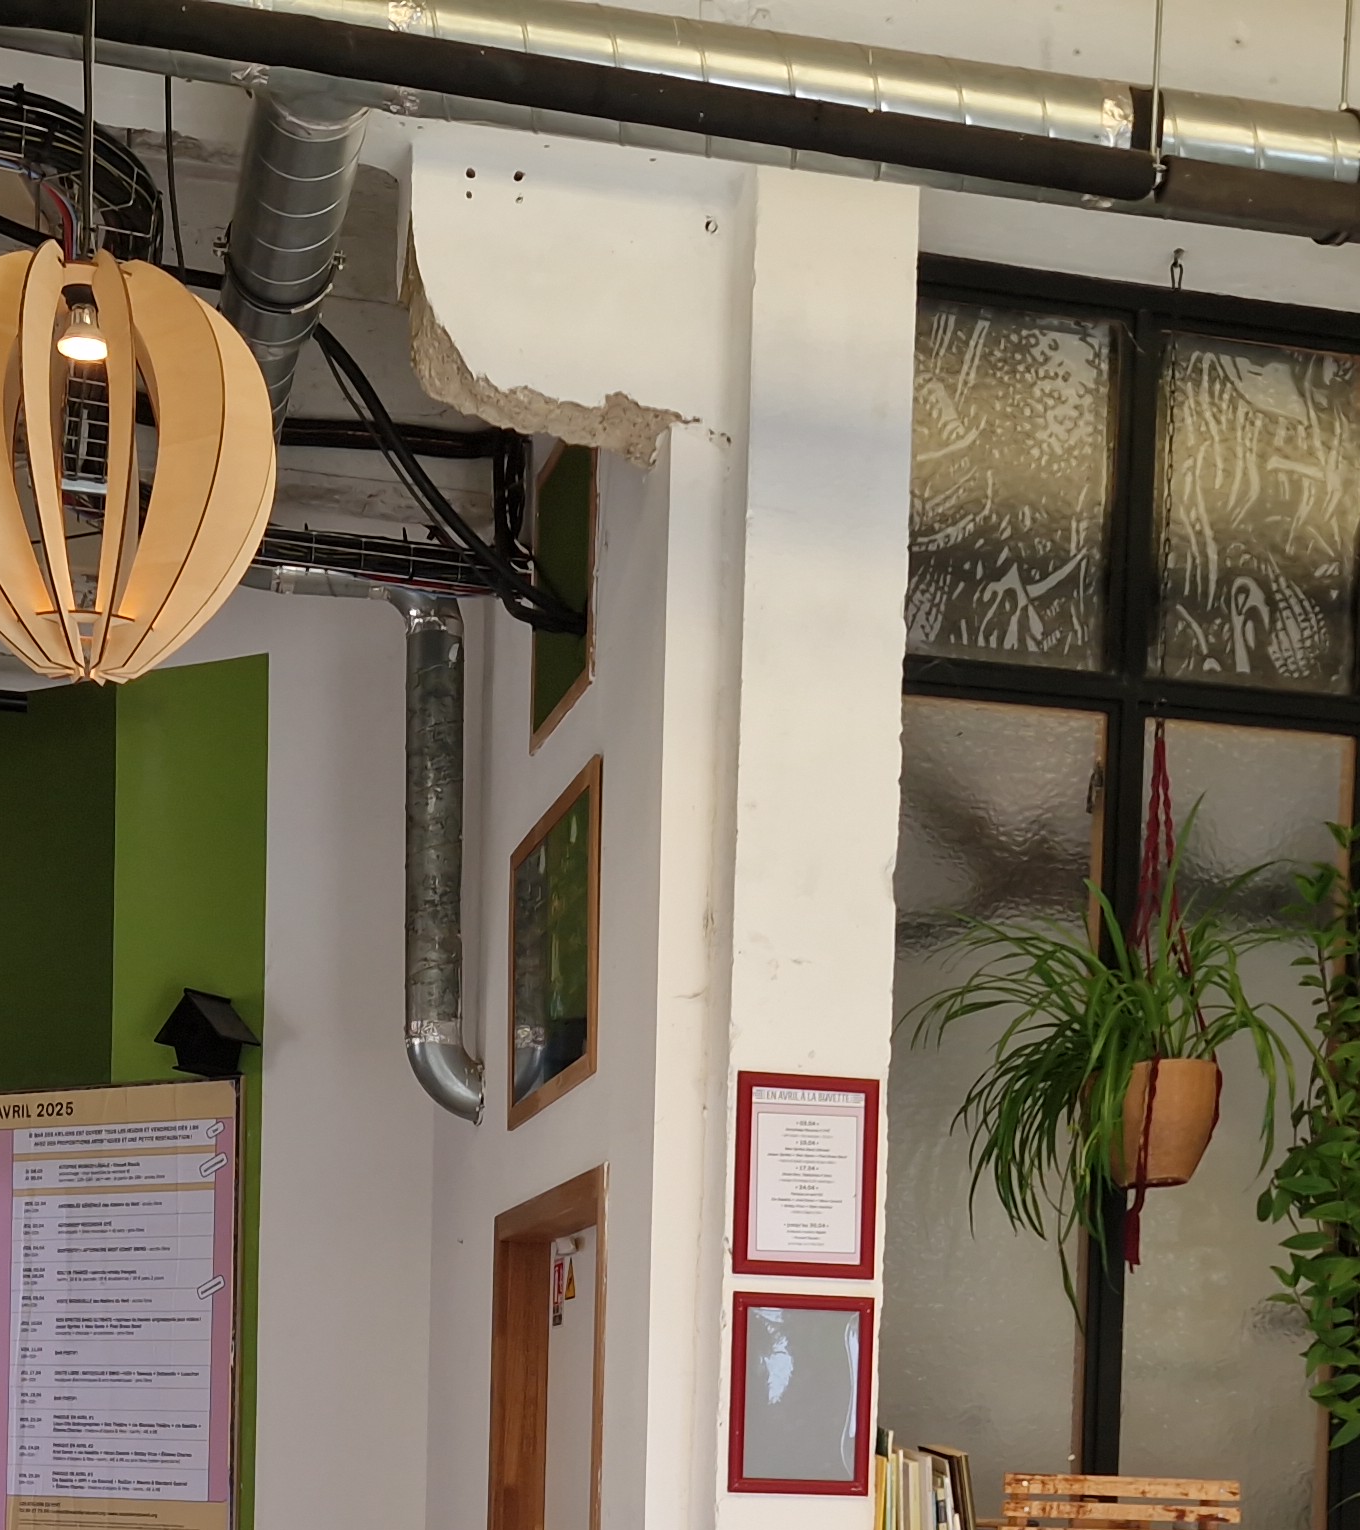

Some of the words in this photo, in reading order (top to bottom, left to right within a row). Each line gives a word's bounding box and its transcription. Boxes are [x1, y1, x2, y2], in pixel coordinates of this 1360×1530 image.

[767, 1090, 776, 1100] EN
[779, 1091, 799, 1100] AVRIL
[808, 1092, 816, 1101] LA
[37, 1102, 74, 1117] 2025
